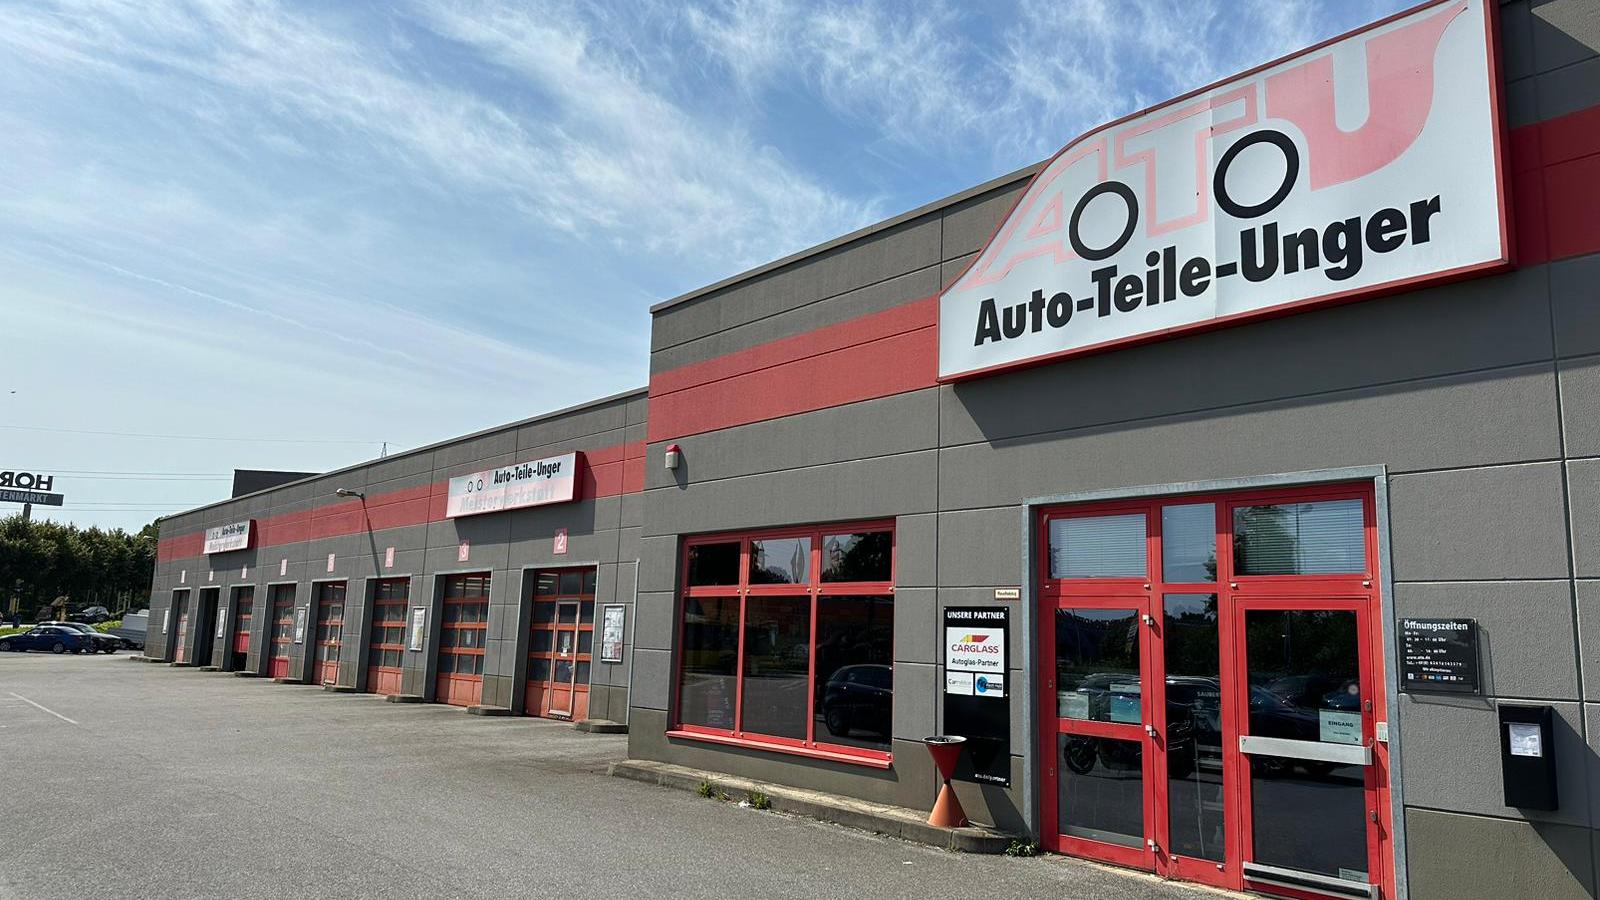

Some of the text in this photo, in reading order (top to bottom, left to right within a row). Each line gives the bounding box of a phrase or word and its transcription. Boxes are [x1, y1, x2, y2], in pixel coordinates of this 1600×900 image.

[974, 195, 1440, 346] Auto-Teile-Unger
[494, 462, 561, 484] Auto-Teile-Unger
[557, 533, 564, 550] 2
[947, 611, 972, 619] UNSERE
[1404, 619, 1468, 631] Öffnungszeiten
[951, 644, 999, 653] CARGLASS
[951, 658, 999, 667] Autoglas-Partner
[1328, 720, 1354, 728] EINGANG
